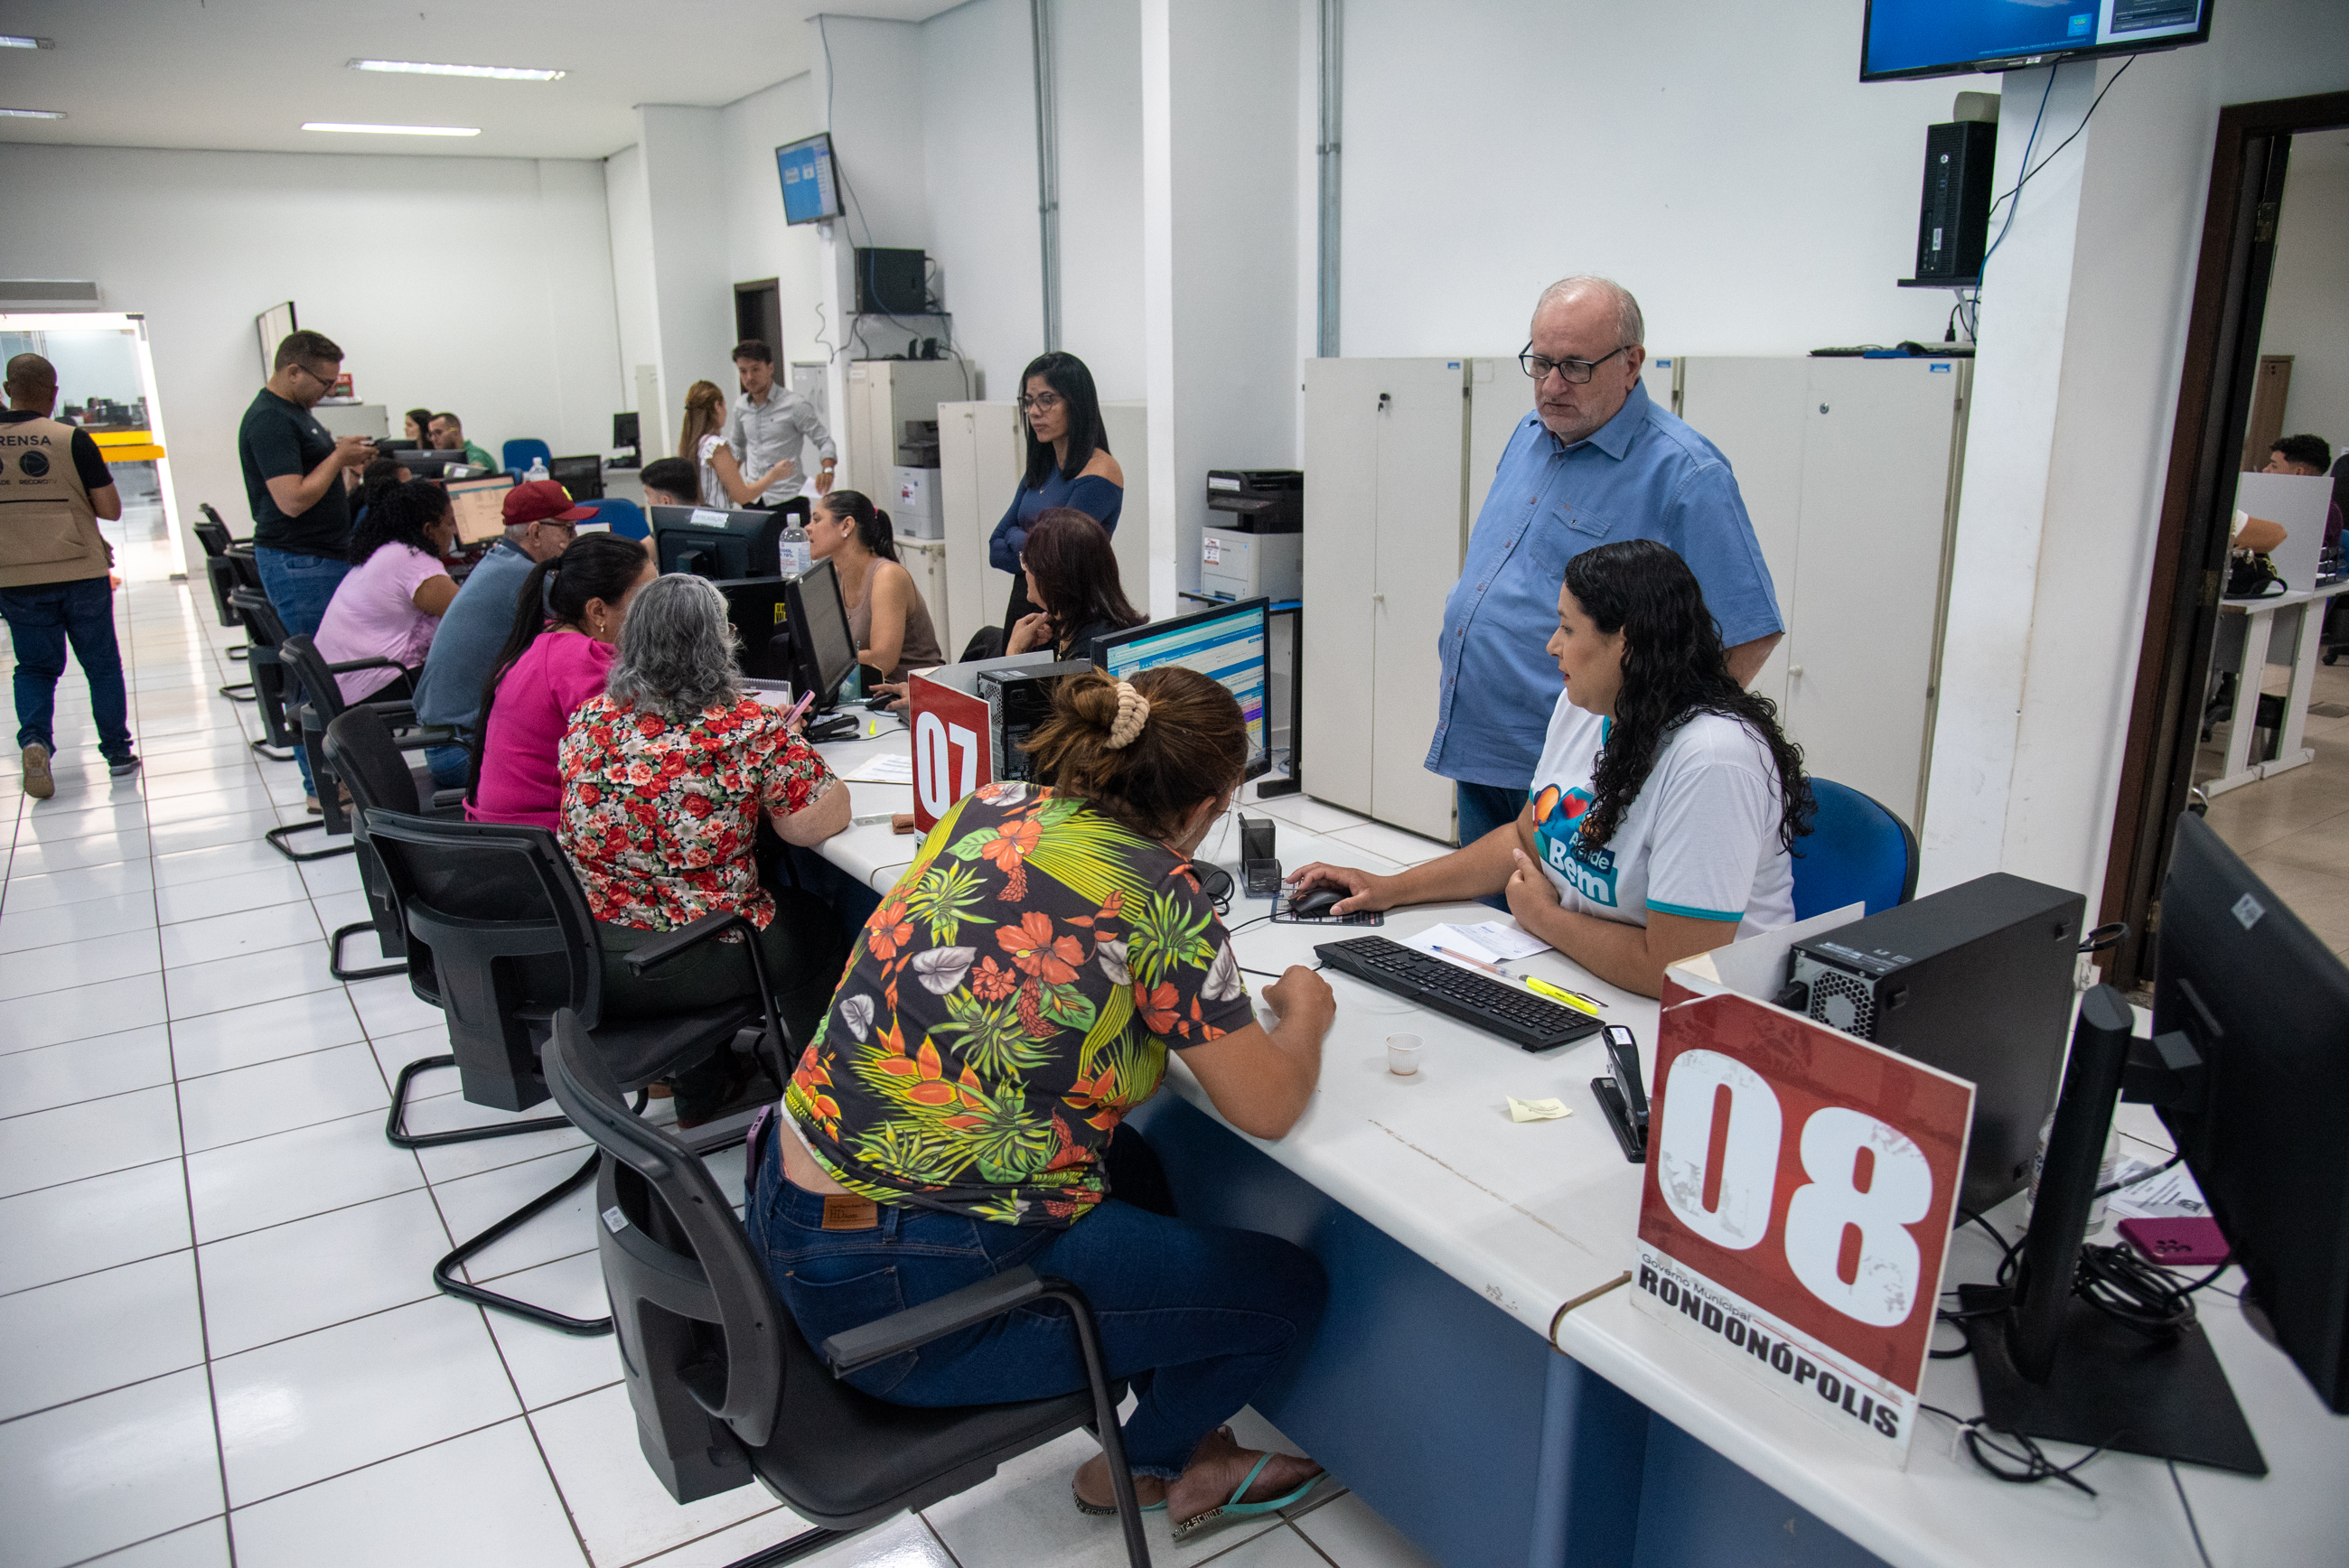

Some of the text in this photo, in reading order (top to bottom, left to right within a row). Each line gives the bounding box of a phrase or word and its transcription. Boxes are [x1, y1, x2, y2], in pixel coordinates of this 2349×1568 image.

[916, 711, 978, 820] 07
[1549, 837, 1610, 902] Bem
[1658, 1049, 1933, 1327] 08
[1642, 1254, 1752, 1322] Governo Municipal
[1638, 1264, 1900, 1439] RONDONÓPOLIS
